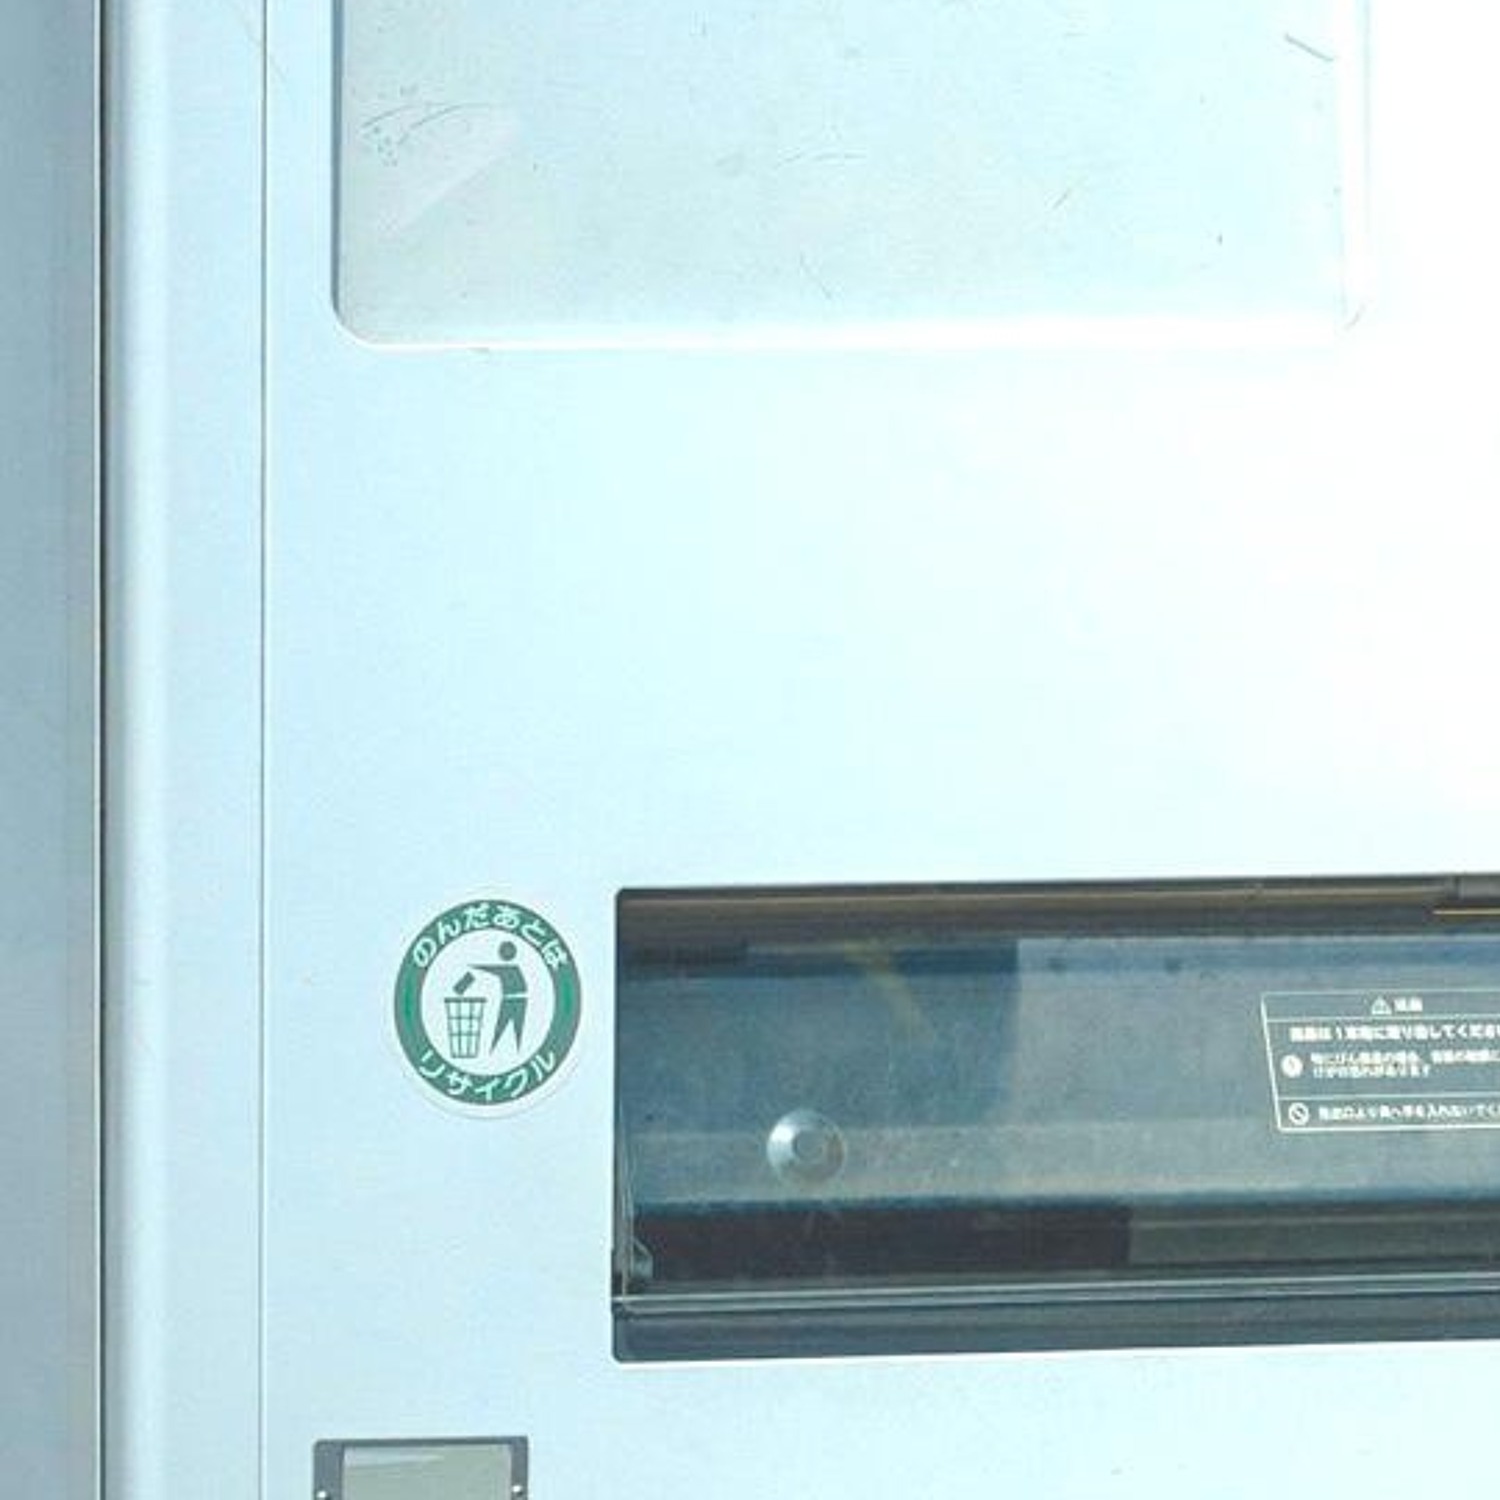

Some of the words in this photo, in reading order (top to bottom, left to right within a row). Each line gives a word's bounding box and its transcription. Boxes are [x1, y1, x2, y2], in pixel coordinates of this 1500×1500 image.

[412, 903, 569, 970] のんだあとは
[418, 1049, 556, 1102] リサイクル
